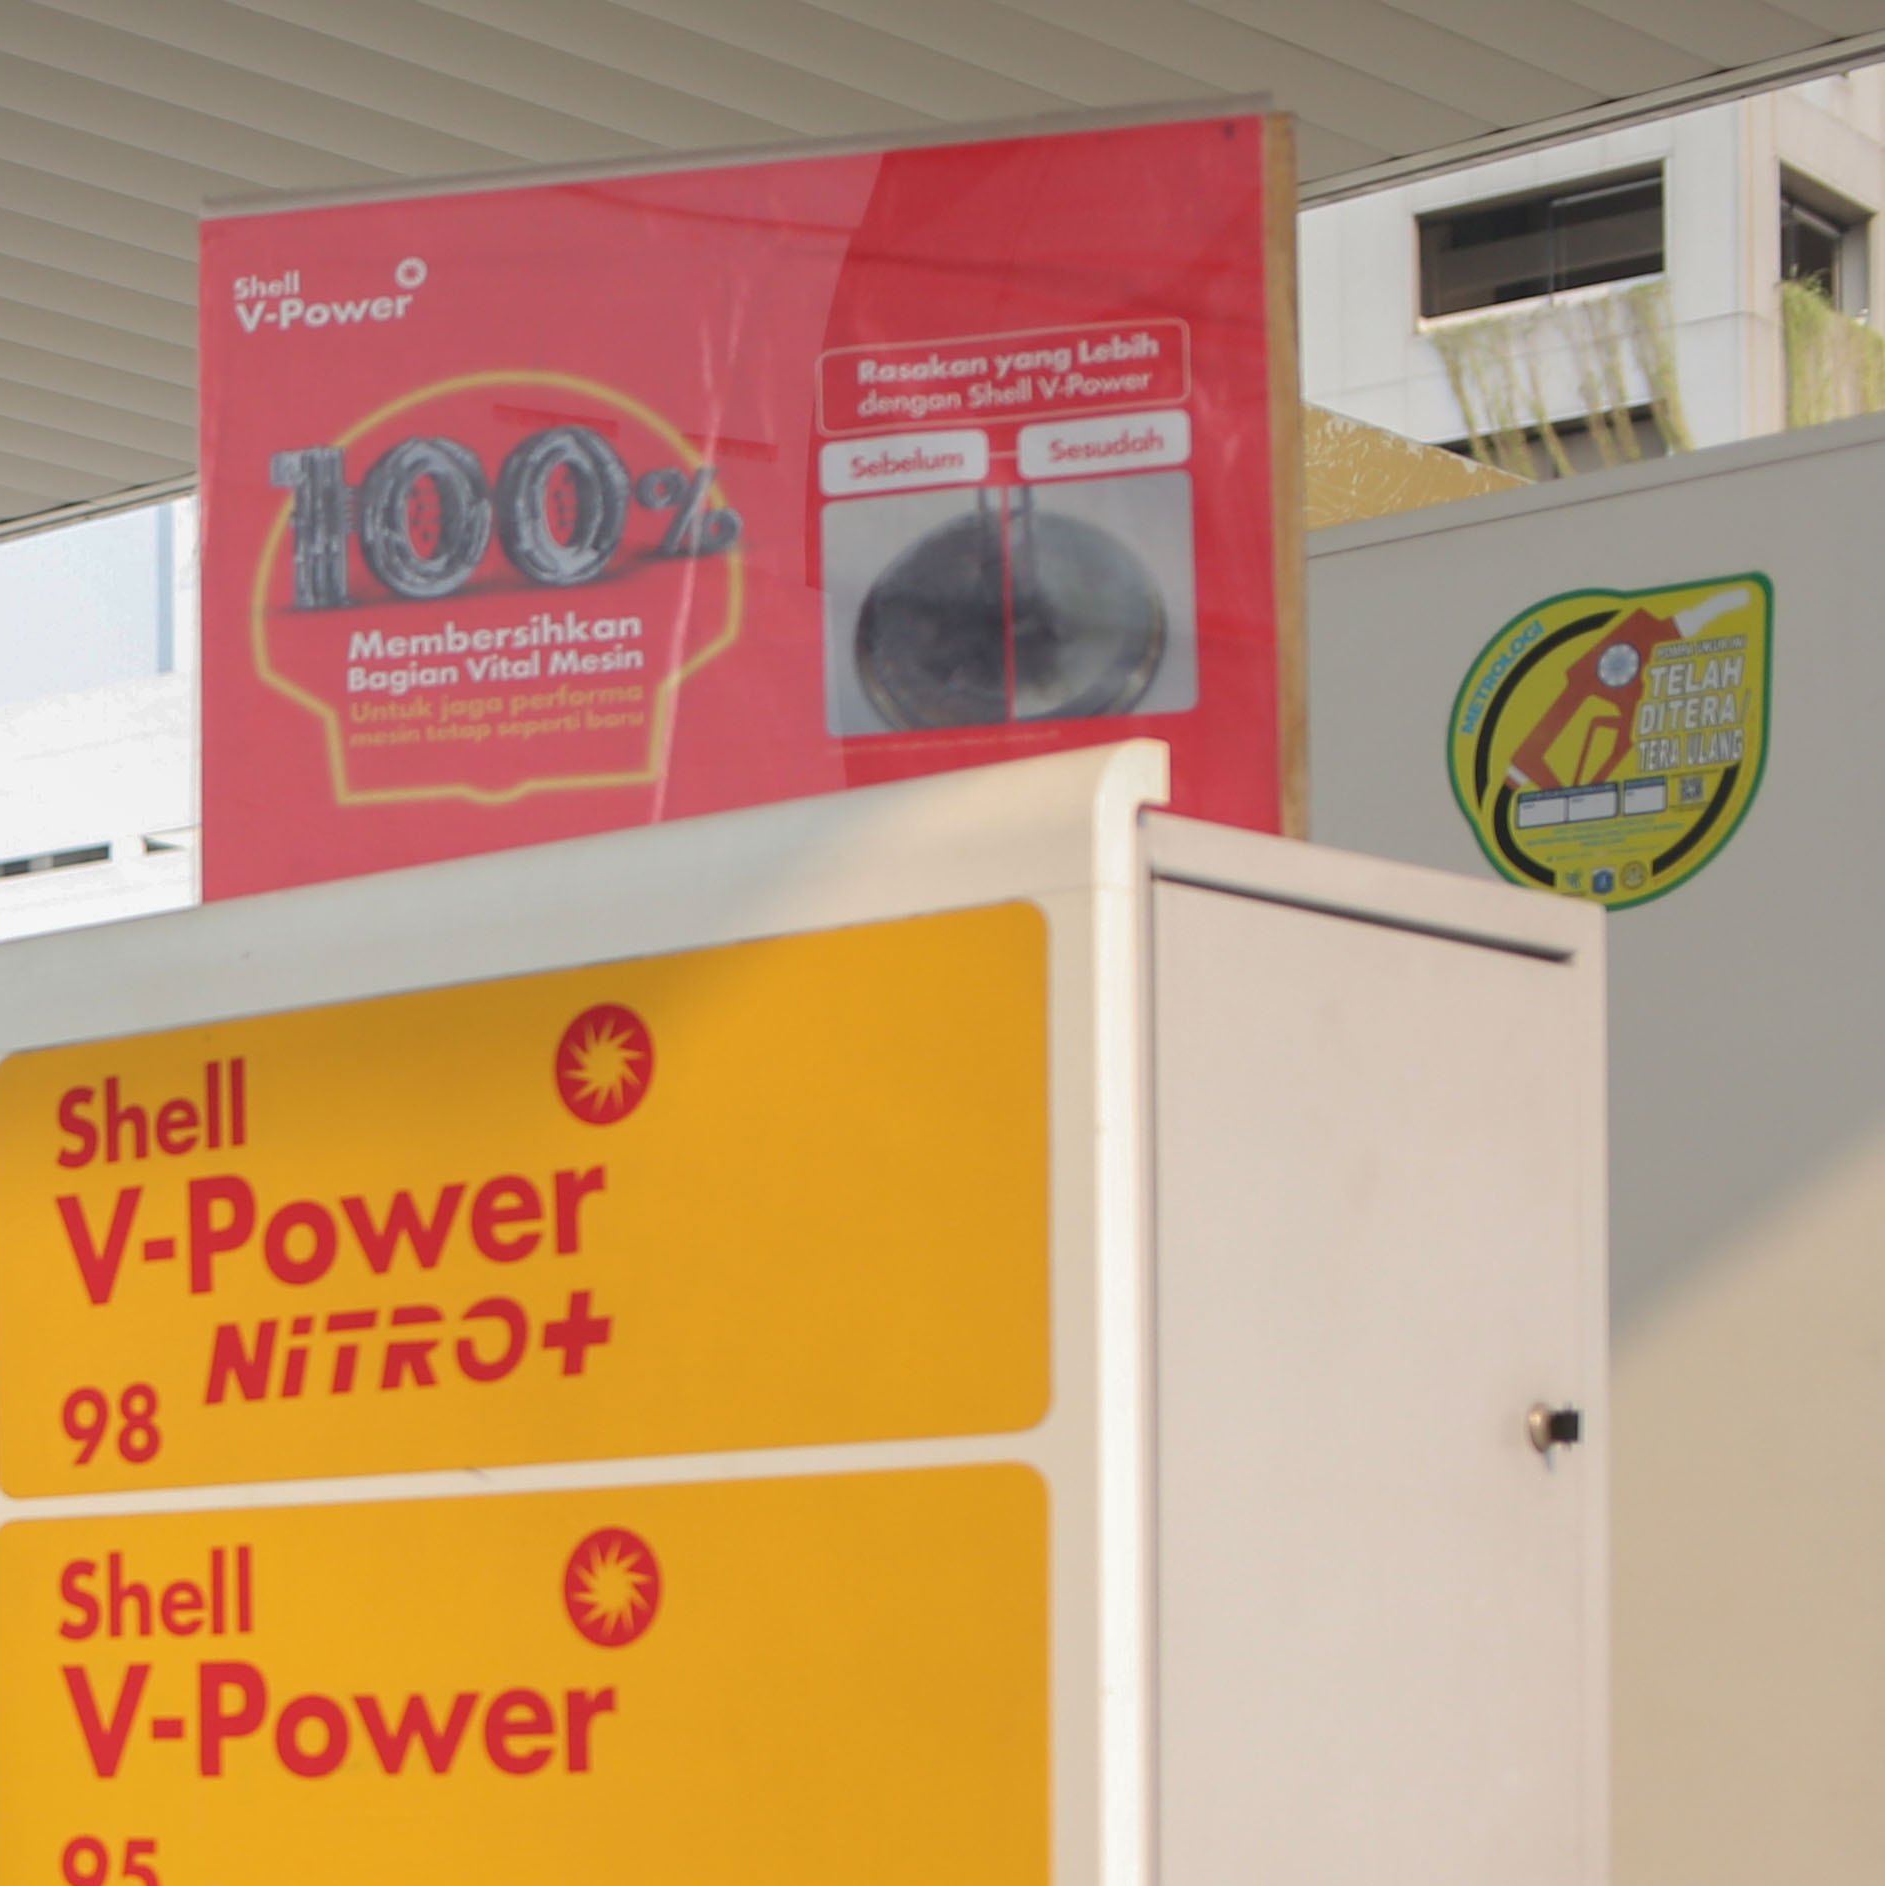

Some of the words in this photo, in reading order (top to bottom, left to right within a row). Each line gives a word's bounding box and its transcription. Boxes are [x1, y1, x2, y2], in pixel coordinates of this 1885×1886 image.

[235, 271, 299, 300] Shell
[236, 289, 412, 333] V-Power
[858, 354, 984, 386] Rasakan
[996, 345, 1068, 380] yang
[1077, 335, 1159, 363] Lebih
[858, 386, 959, 418] dengan
[967, 377, 1029, 406] Shell
[1037, 366, 1151, 400] V-Power
[849, 447, 963, 478] Sebelum
[1047, 429, 1164, 462] Sesudah
[271, 425, 742, 611] 100%
[348, 612, 642, 663] Membersihkan
[347, 655, 458, 695] Bagian
[468, 648, 541, 685] Vital
[549, 643, 644, 676] Mesin
[1462, 621, 1545, 734] METROLOGI
[1650, 655, 1745, 698] TELAH
[349, 725, 420, 749] mesin
[427, 719, 491, 747] tetap
[498, 713, 573, 744] seperti
[580, 706, 644, 732] baru
[350, 692, 431, 727] Untuk
[440, 690, 501, 726] jaga
[510, 681, 644, 720] performa
[1638, 736, 1678, 773] TERA
[1686, 729, 1745, 765] ULANG
[57, 1056, 246, 1167] Shell
[56, 1165, 606, 1306] V-Power
[60, 1382, 161, 1466] 98
[59, 1545, 253, 1640] Shell
[62, 1661, 616, 1777] V-Power
